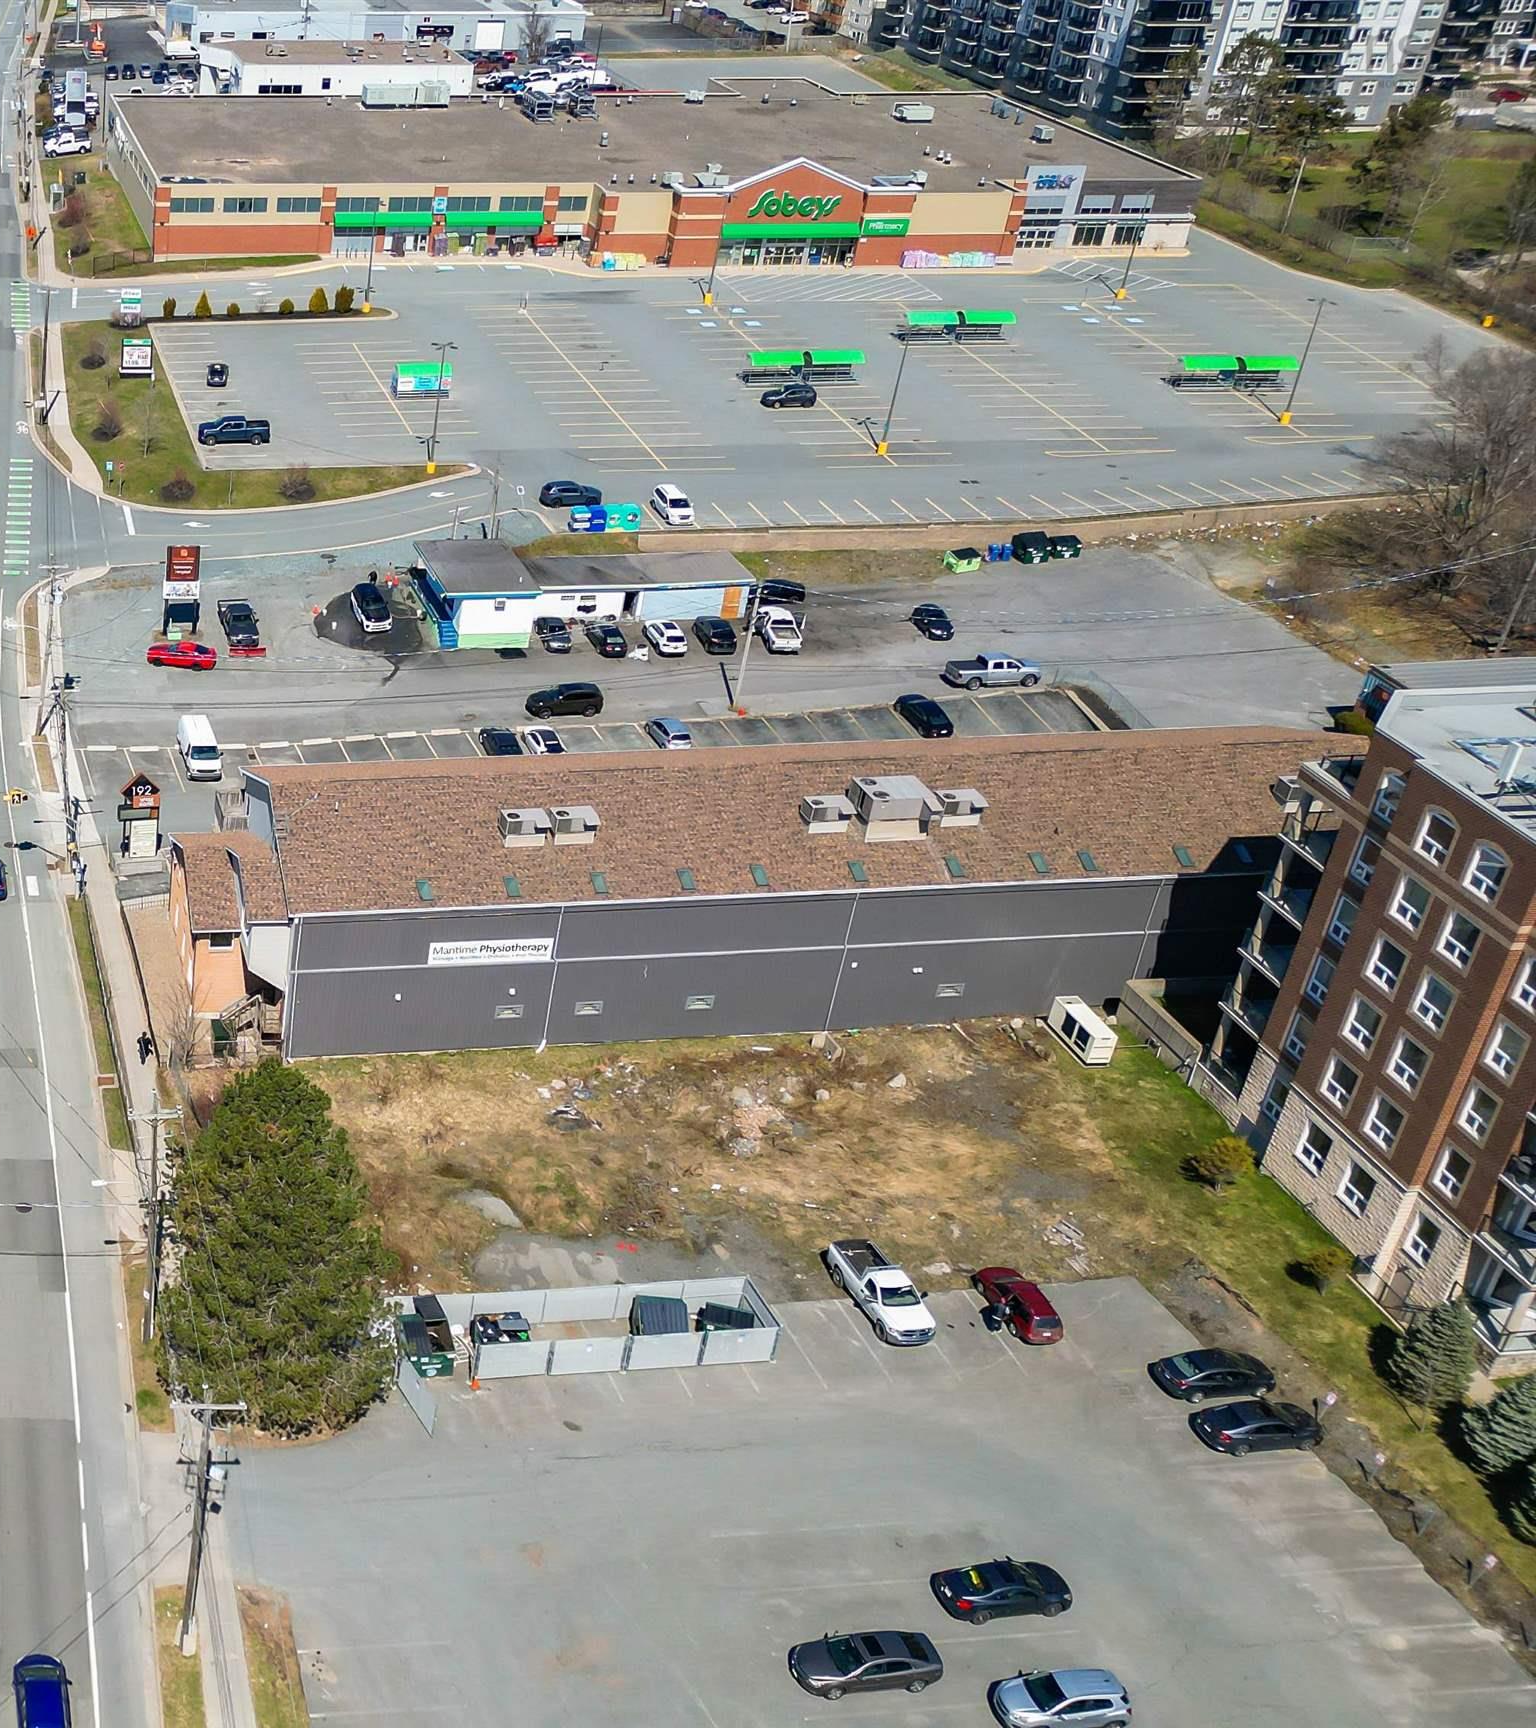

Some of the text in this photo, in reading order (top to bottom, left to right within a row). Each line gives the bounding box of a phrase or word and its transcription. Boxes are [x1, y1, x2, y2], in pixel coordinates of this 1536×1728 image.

[747, 189, 842, 220] Sobeys
[868, 222, 904, 232] Pharmacy
[132, 785, 152, 796] 192
[480, 943, 549, 954] Physiotherapy
